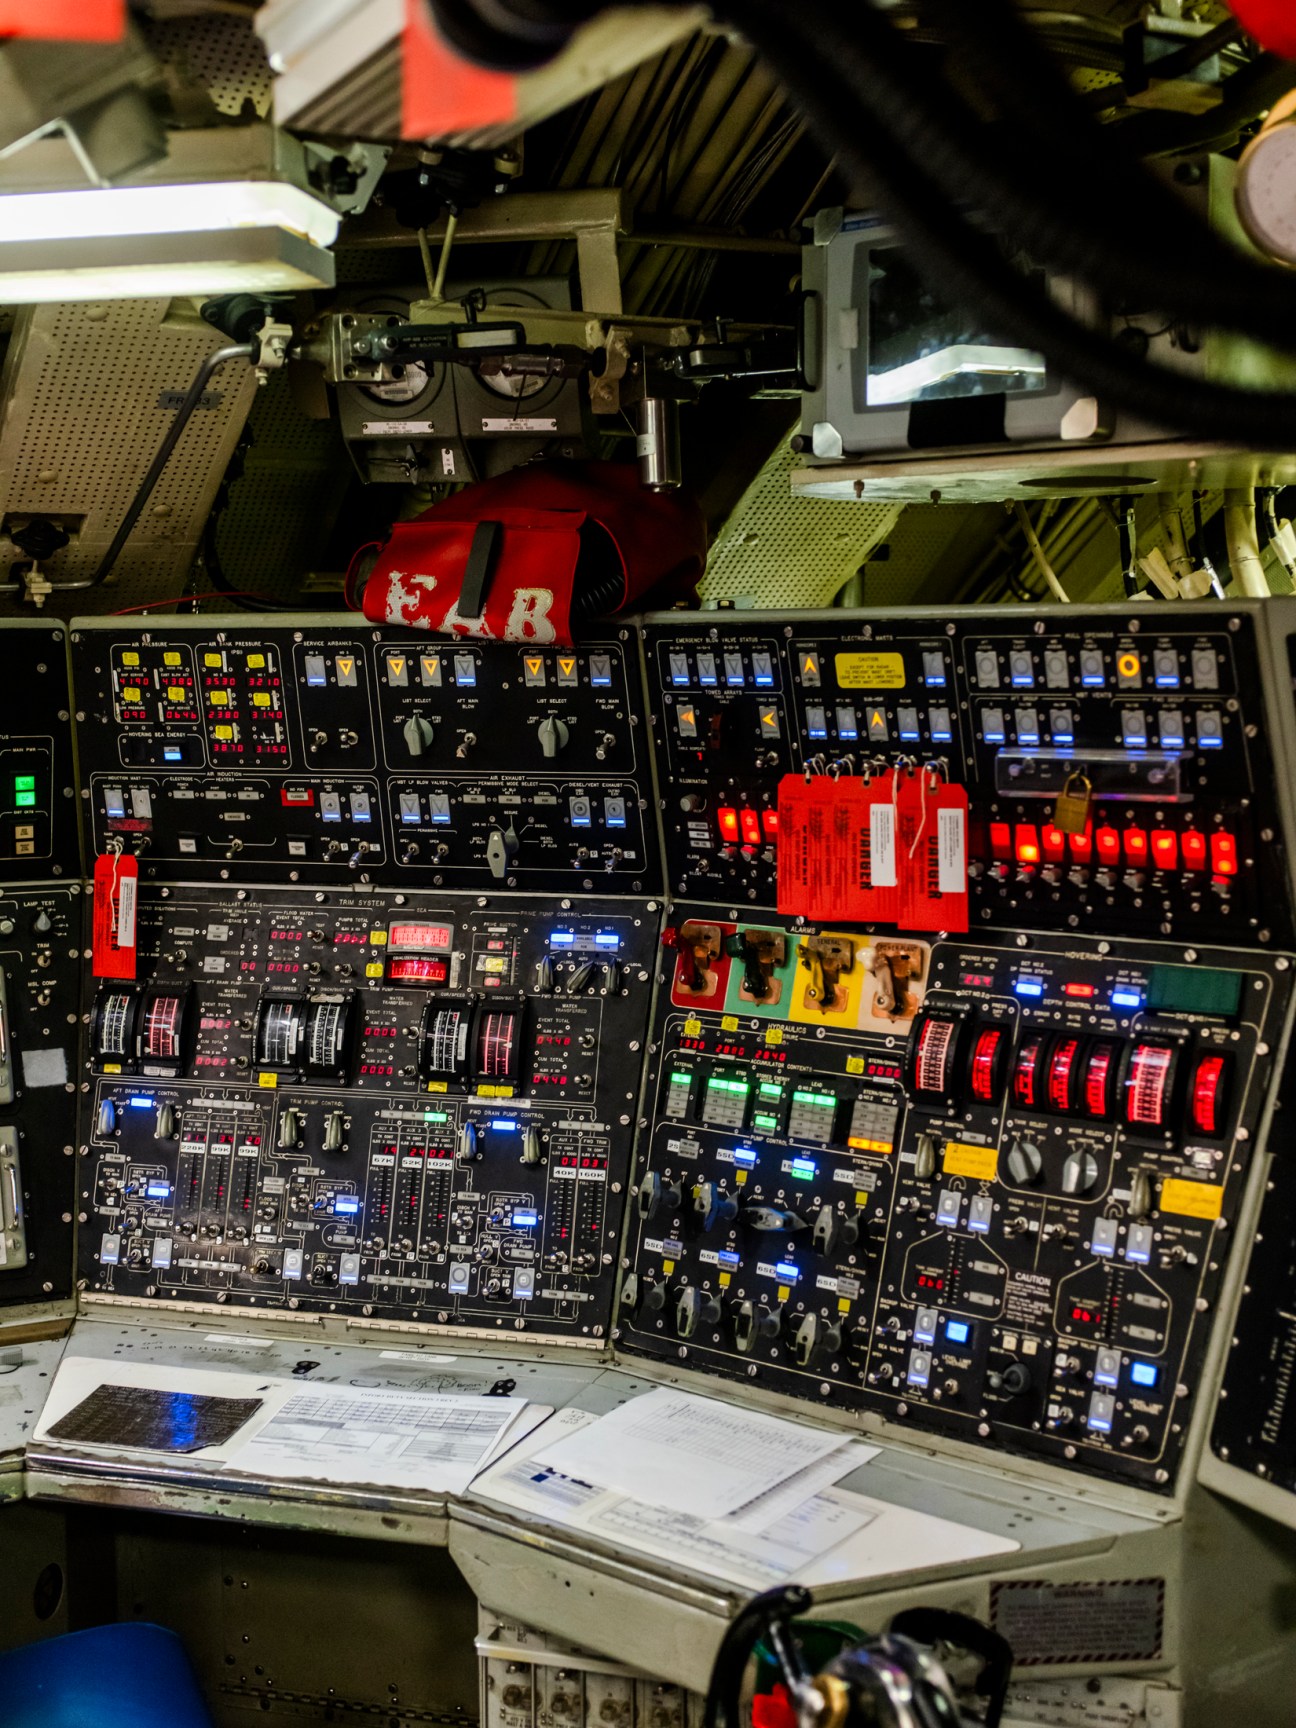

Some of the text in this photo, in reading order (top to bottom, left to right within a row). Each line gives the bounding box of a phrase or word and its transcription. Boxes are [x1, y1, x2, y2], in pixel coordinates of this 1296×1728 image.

[162, 678, 192, 686] 4380
[206, 678, 235, 686] 3530
[124, 711, 146, 719] 090
[214, 744, 244, 752] 3870
[256, 745, 286, 753] 3150
[790, 926, 816, 934] ALARMS
[271, 931, 302, 940] 0000
[1065, 951, 1103, 961] HOVERING
[268, 963, 299, 972] 0000
[1065, 1001, 1092, 1010] CONTROL
[365, 1028, 396, 1036] 0000
[768, 1024, 807, 1034] HYDRAULICS
[537, 1036, 571, 1045] 0448
[755, 1050, 786, 1061] 2840
[196, 1058, 228, 1066] 0002
[750, 1059, 812, 1072] ACCUMULATOR CONTENTS
[361, 1066, 393, 1074] 0000
[533, 1076, 567, 1085] 0448
[766, 1138, 788, 1146] CONTROL
[384, 1146, 397, 1154] 19
[409, 1148, 425, 1156] 24
[429, 1149, 453, 1158] 021
[562, 1157, 577, 1166] 03
[583, 1157, 607, 1168] 031
[1015, 1272, 1051, 1286] CAUTION
[1053, 1588, 1104, 1598] WARNING
